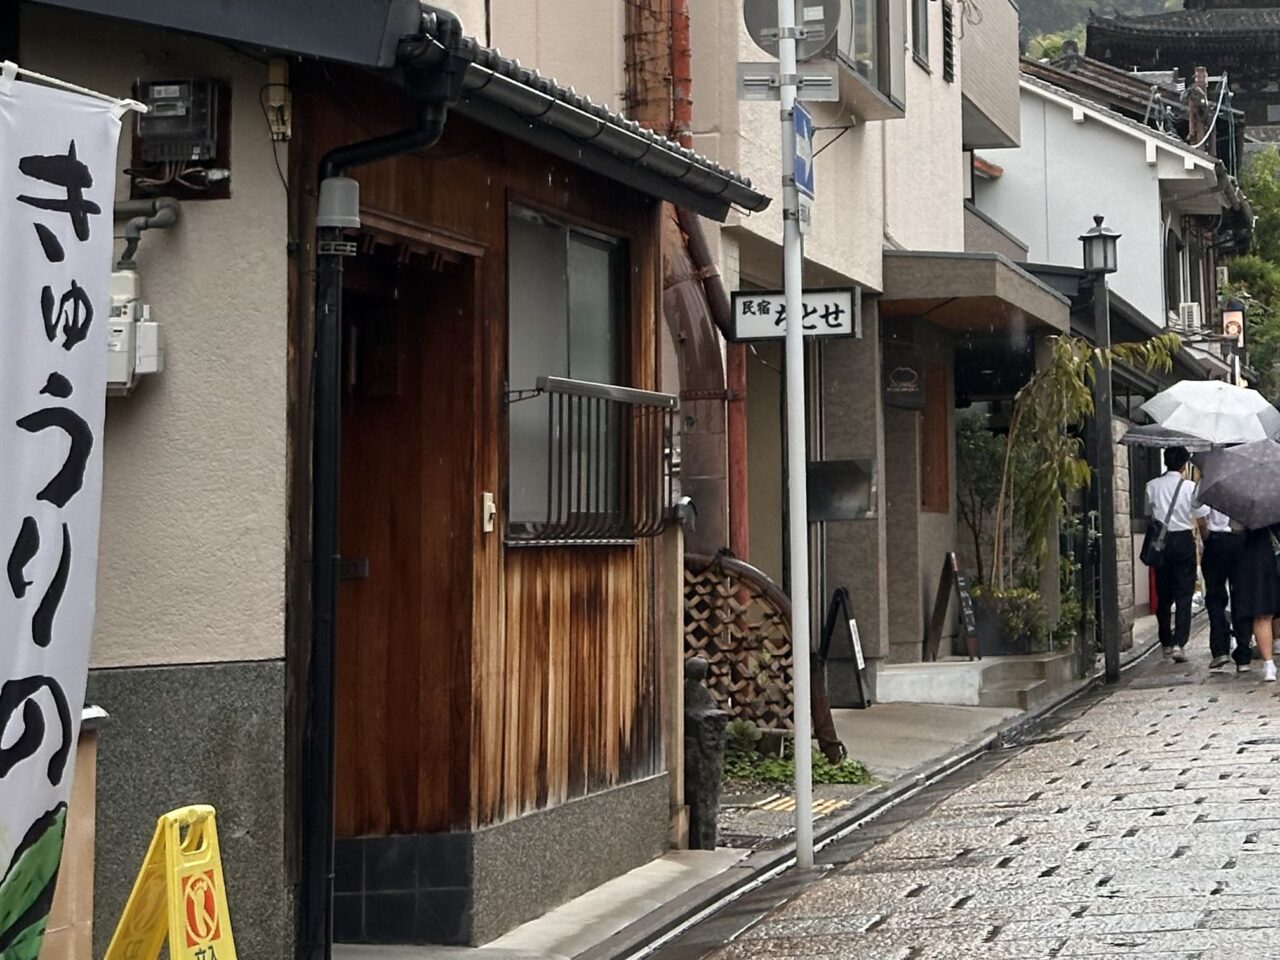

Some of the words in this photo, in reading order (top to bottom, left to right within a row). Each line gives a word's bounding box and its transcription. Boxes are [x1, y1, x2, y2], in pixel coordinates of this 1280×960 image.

[0, 139, 101, 786] きゅうりの
[742, 299, 771, 315] 民宿
